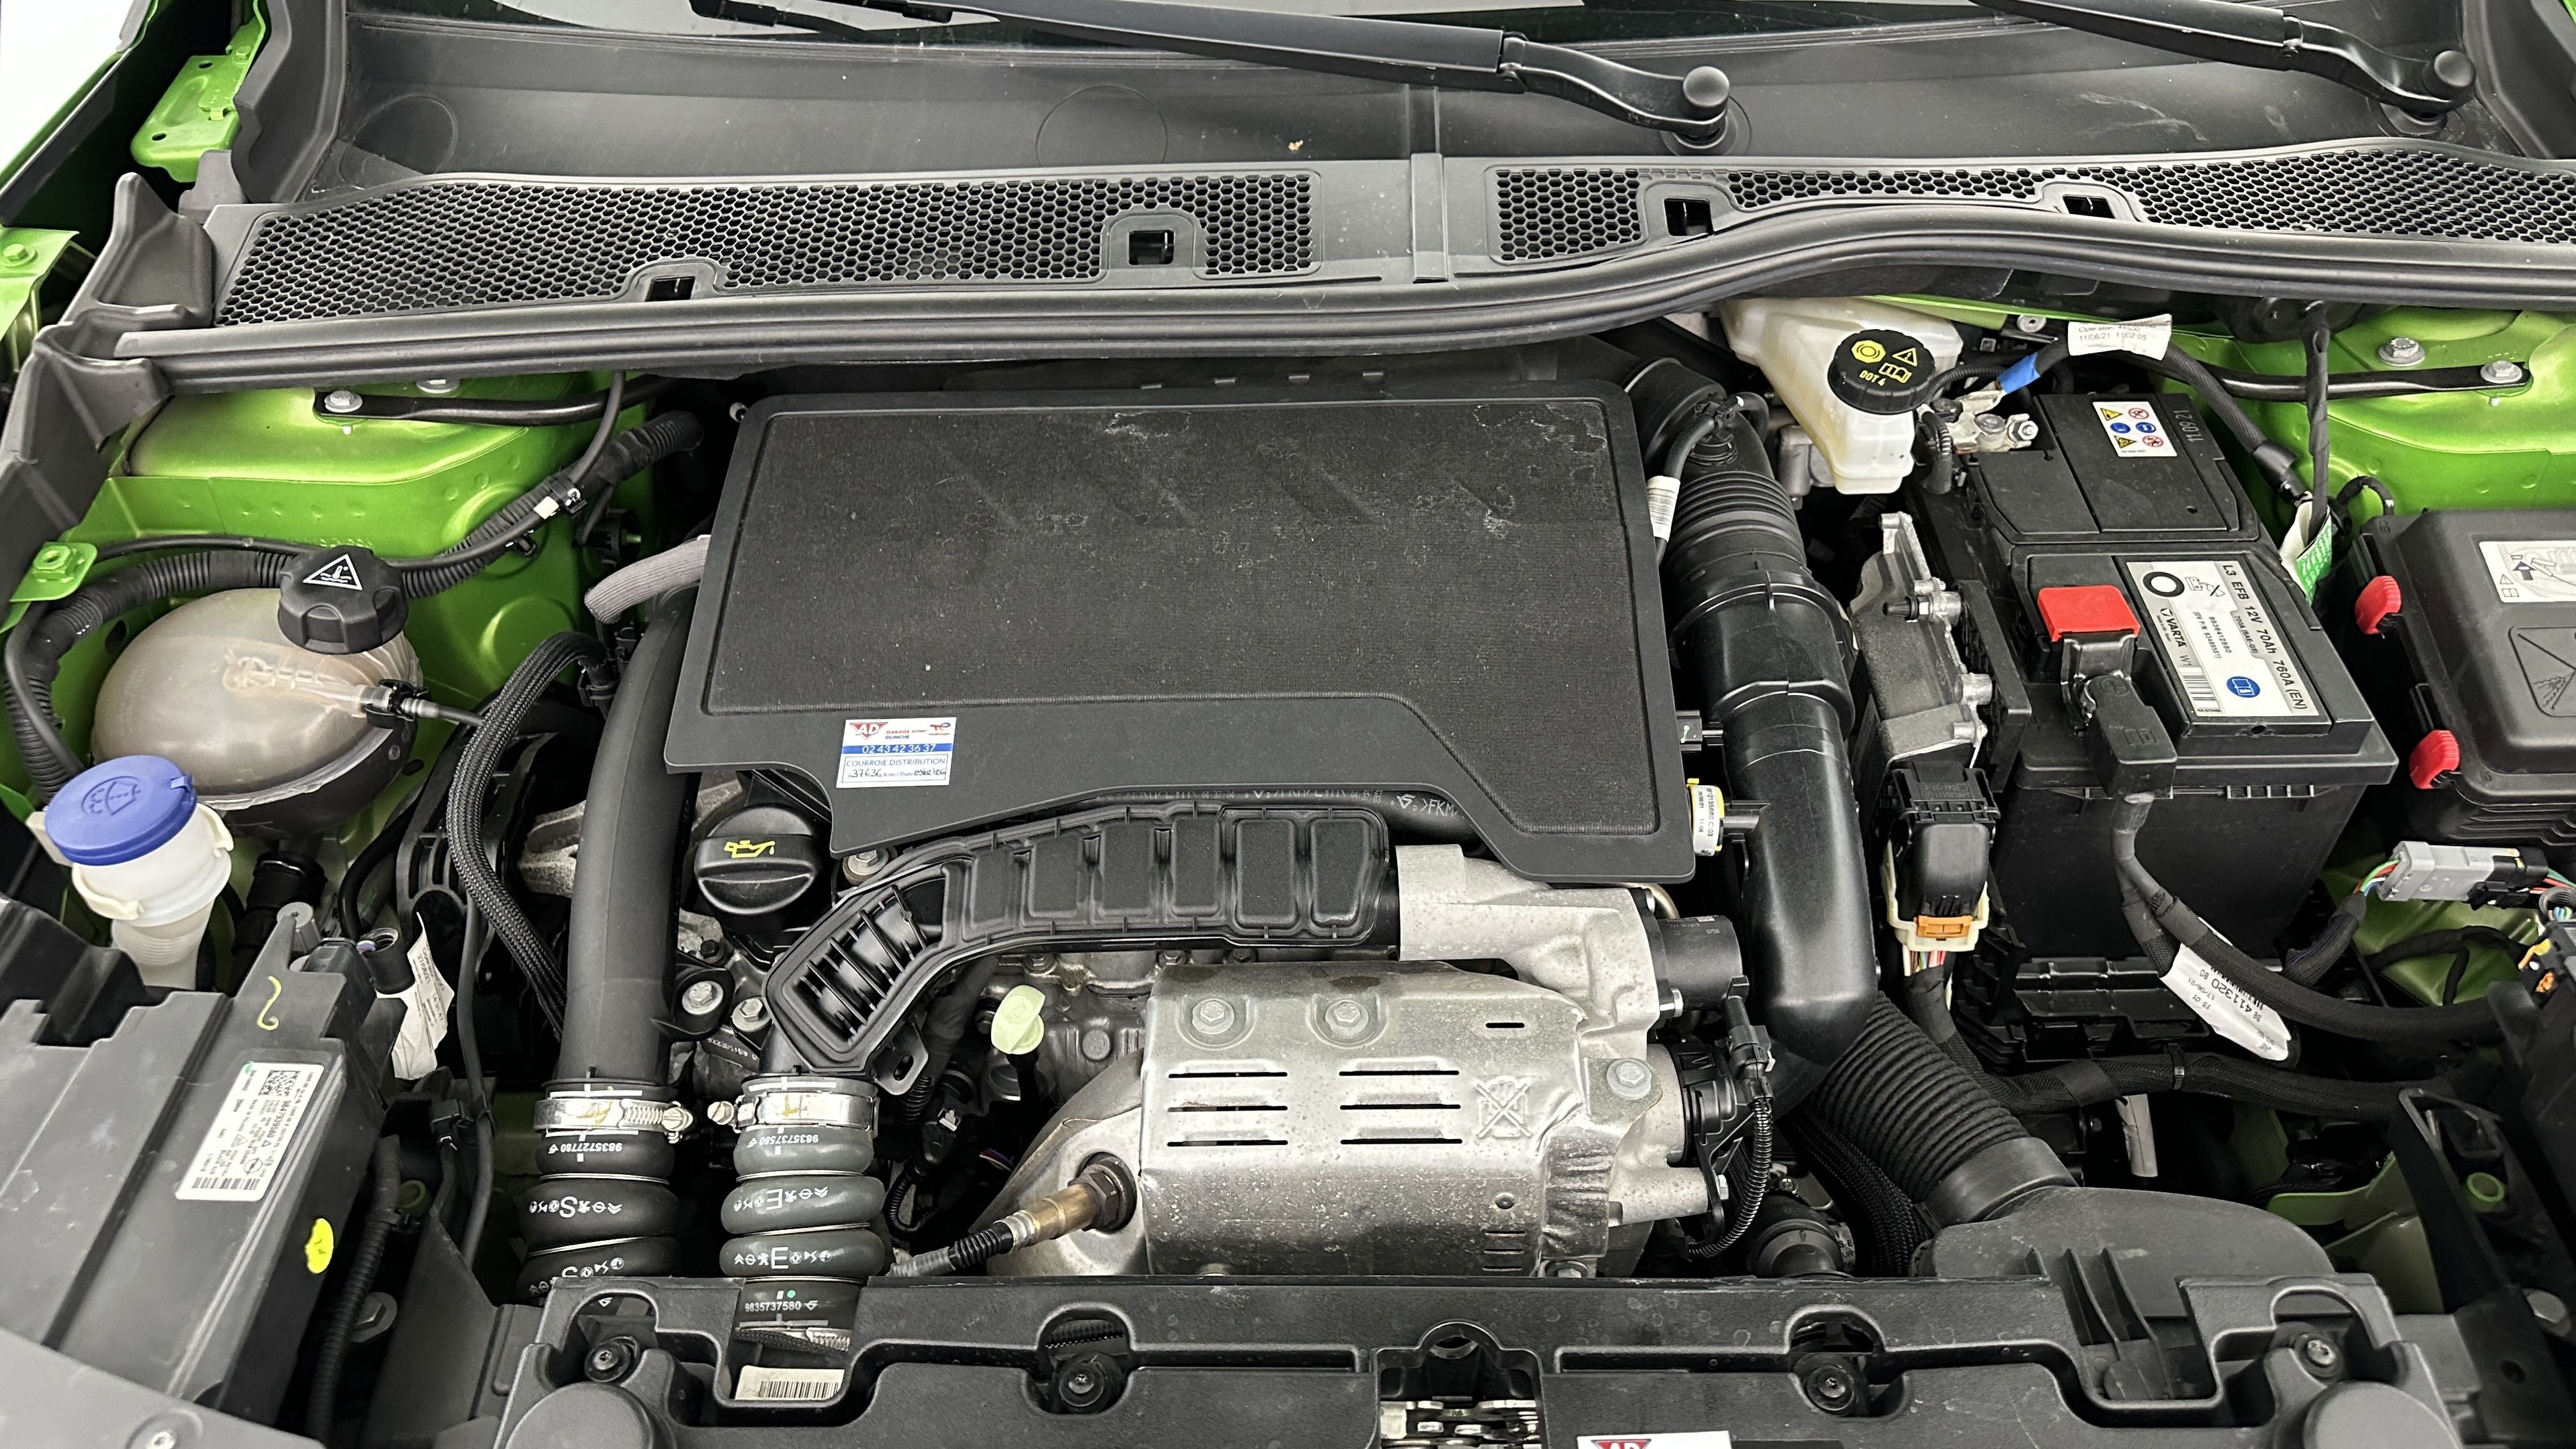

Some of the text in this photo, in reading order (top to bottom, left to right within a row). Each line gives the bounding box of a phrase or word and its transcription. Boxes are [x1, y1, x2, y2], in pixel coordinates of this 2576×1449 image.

[1859, 370, 1887, 386] DOT 4
[2166, 617, 2188, 647] VARTA
[2223, 565, 2308, 710] L3 EFB 12V 70Ah 760A (EN)
[856, 724, 880, 735] AD
[877, 745, 891, 753] 43
[908, 744, 921, 753] 36
[923, 744, 936, 752] 37
[889, 758, 946, 766] DISTRIBUTION
[852, 769, 882, 778] 37636
[2211, 978, 2253, 1013] 411320
[759, 1134, 819, 1146] 9835737580
[560, 1142, 623, 1153] 9835727780
[745, 1301, 802, 1312] 9835737580
